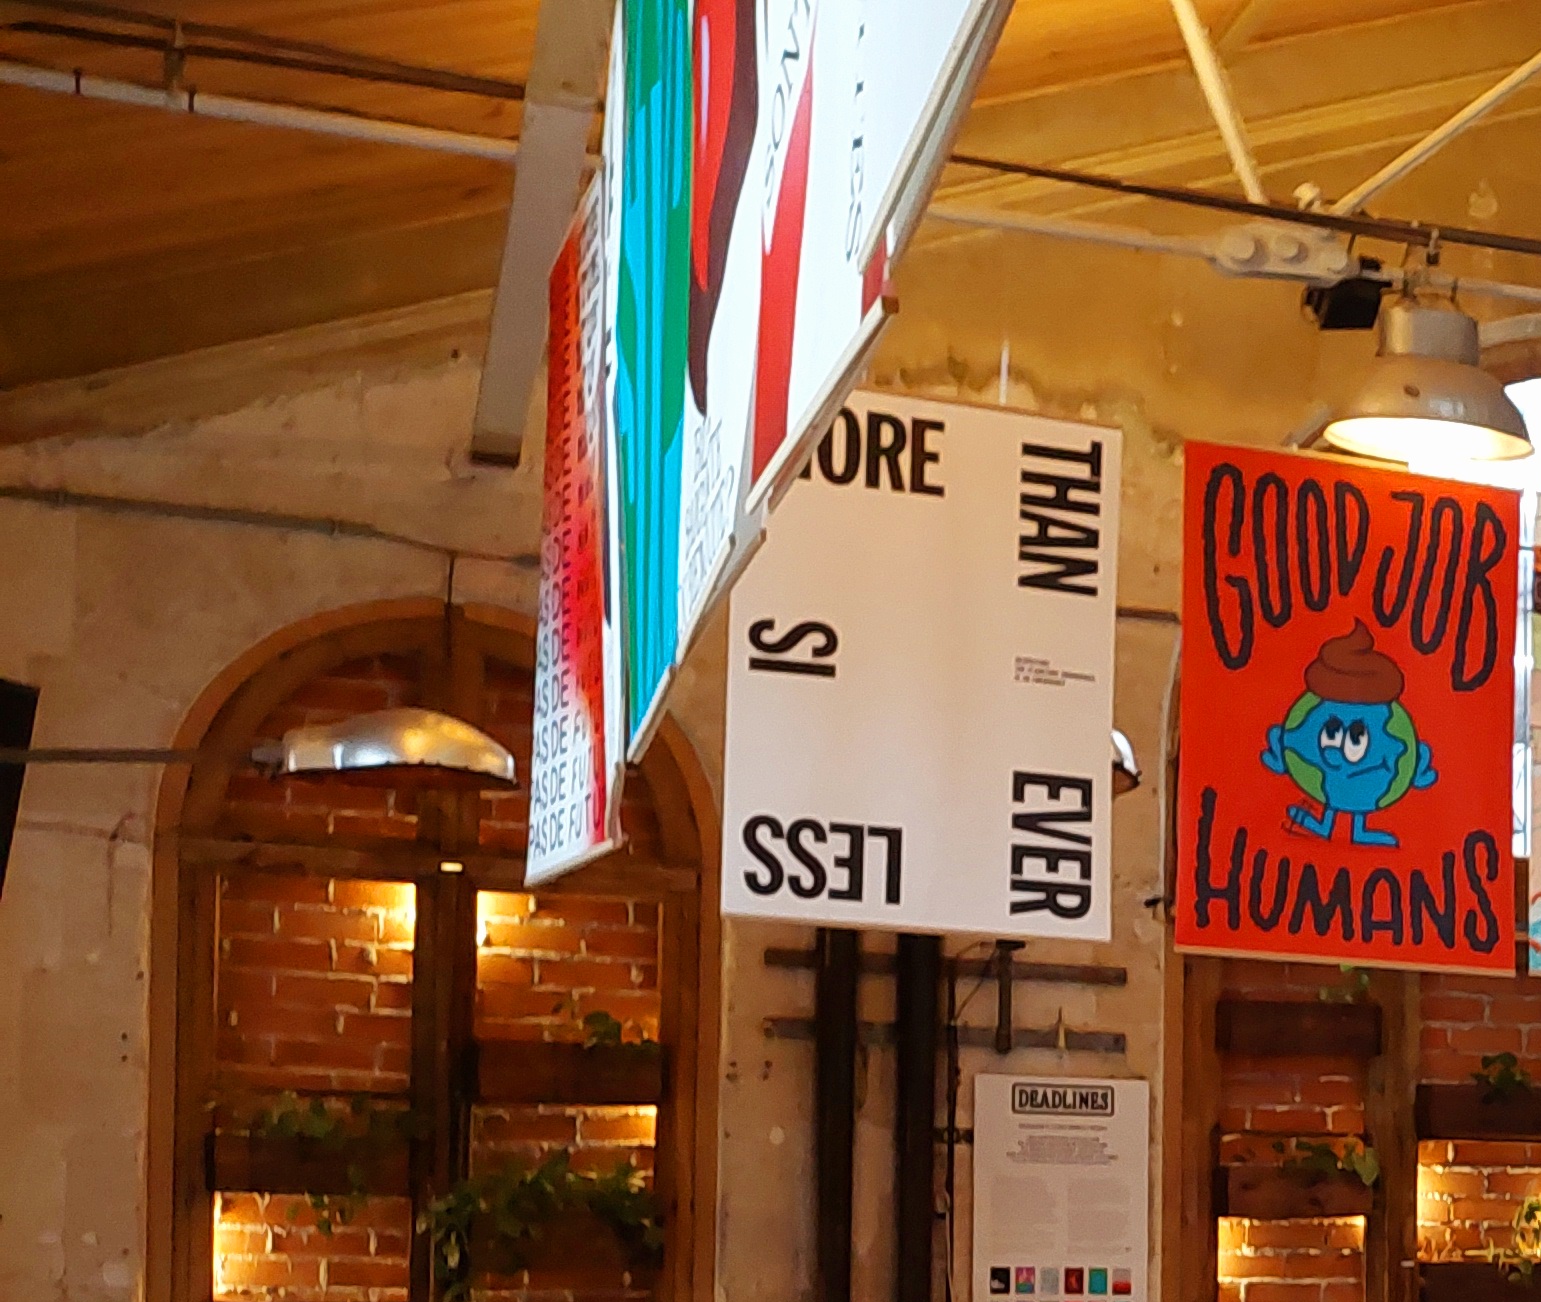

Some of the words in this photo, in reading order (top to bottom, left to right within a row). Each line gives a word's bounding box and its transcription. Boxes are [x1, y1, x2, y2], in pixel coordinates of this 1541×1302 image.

[799, 410, 946, 498] ORE
[1017, 440, 1103, 598] THAN
[1203, 463, 1370, 669] GOOD
[1374, 490, 1506, 691] JOB
[748, 618, 838, 678] IS
[536, 679, 549, 719] AS
[552, 667, 569, 713] DE
[535, 725, 548, 765] AS
[551, 715, 569, 760] DE
[533, 771, 548, 813] AS
[550, 762, 567, 804] DE
[549, 807, 565, 852] DE
[743, 813, 902, 905] LESS
[1009, 771, 1092, 920] EVER
[1195, 787, 1500, 953] HUMANS
[1018, 1088, 1109, 1111] DEADLINES
